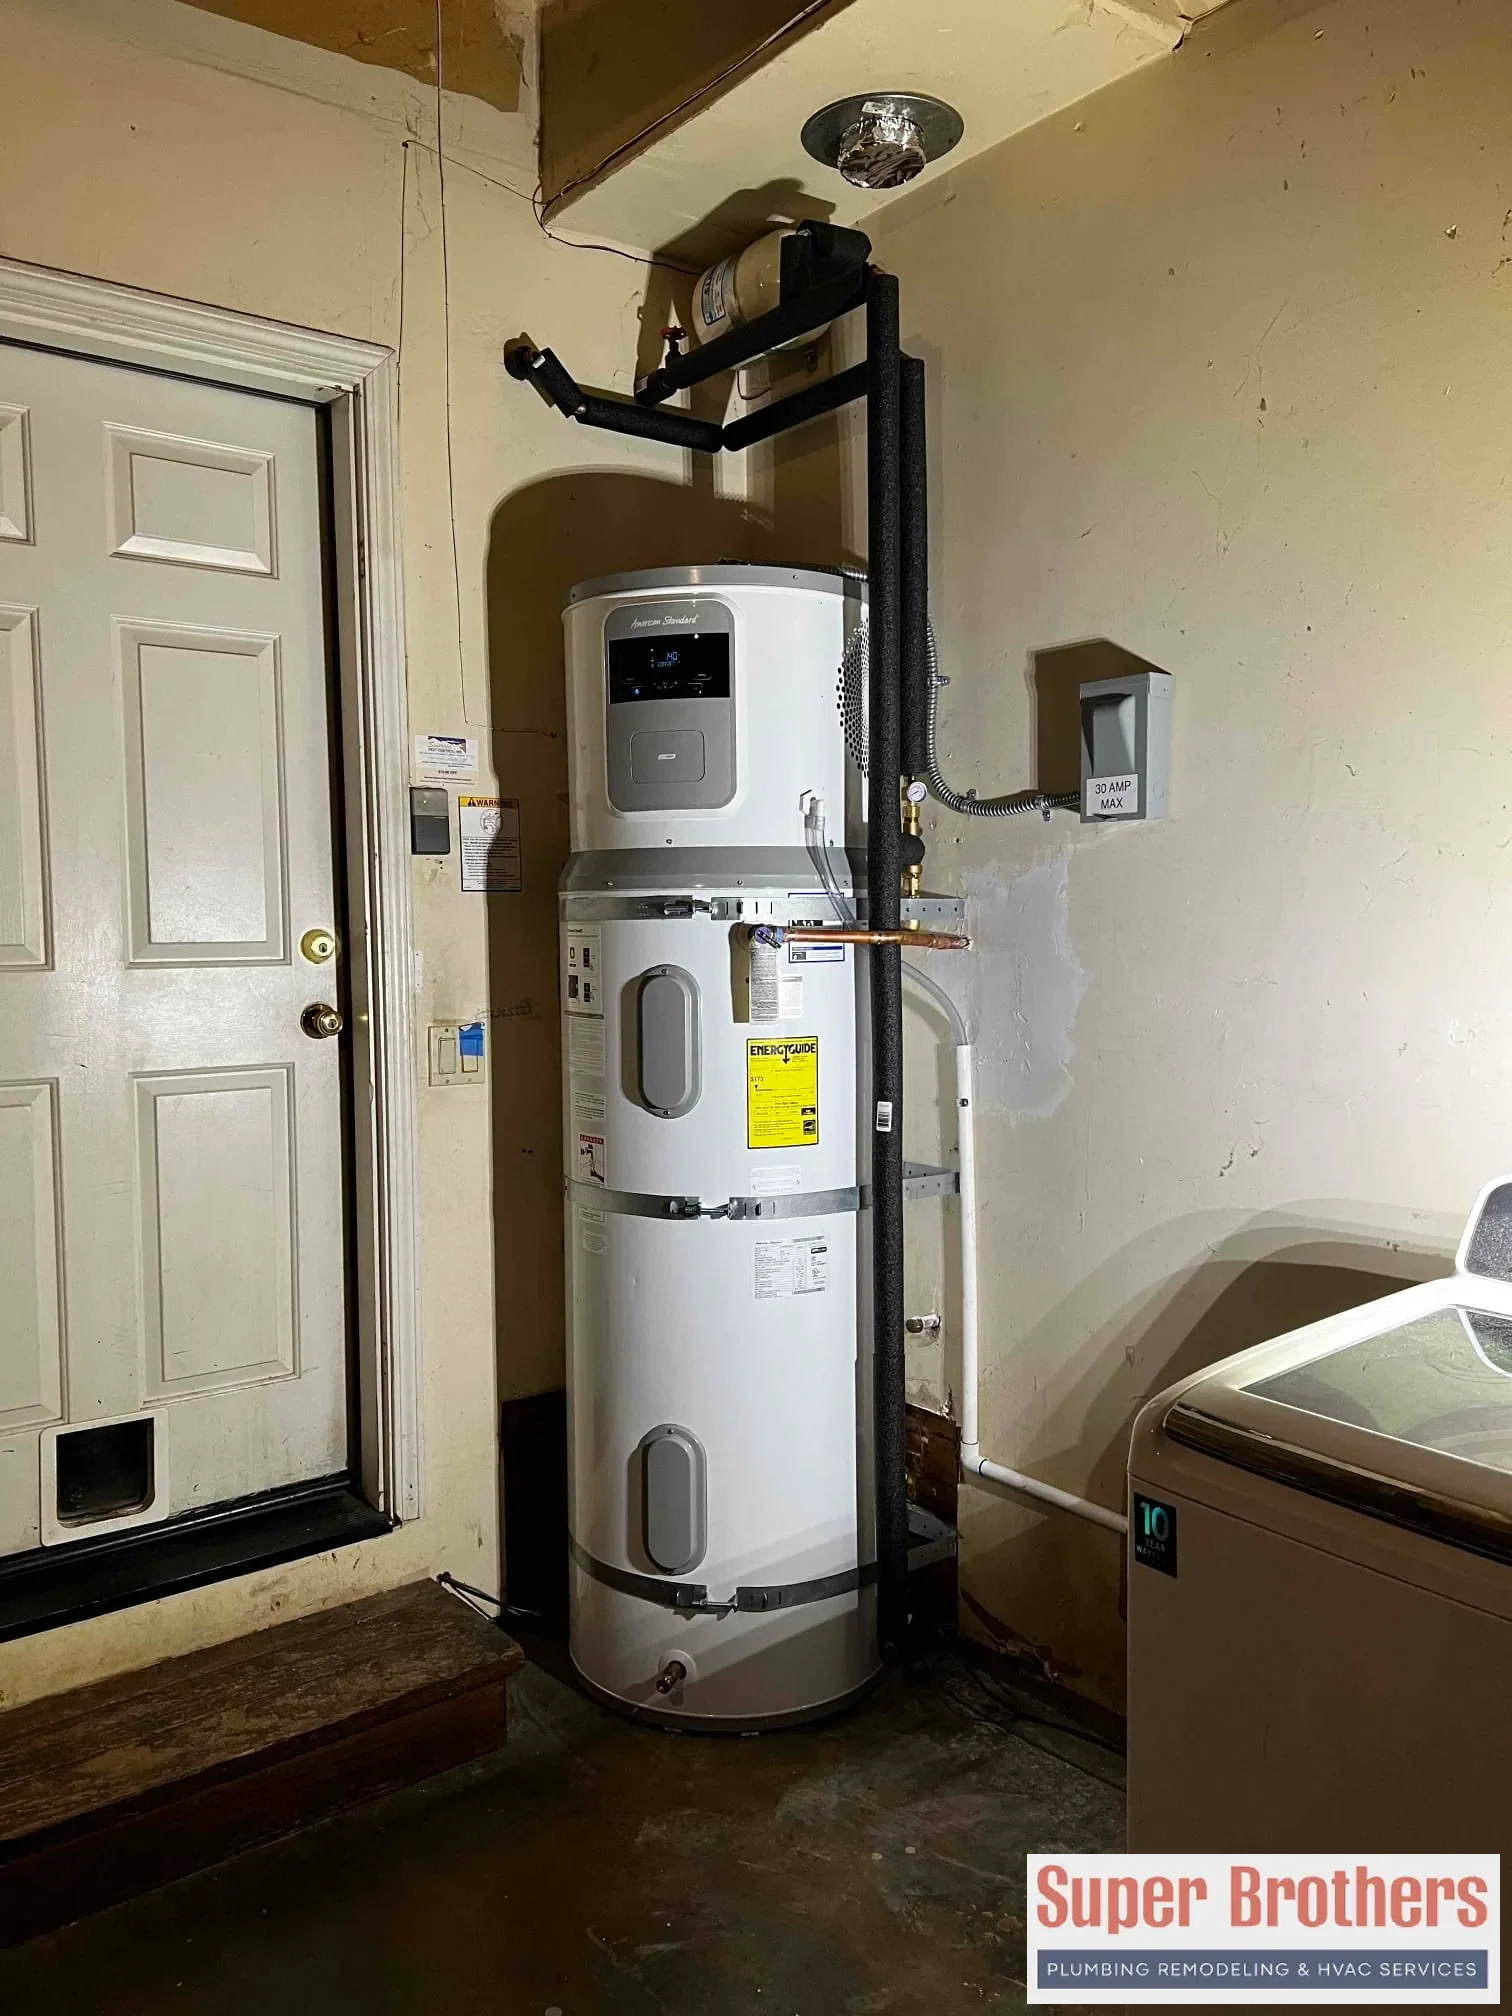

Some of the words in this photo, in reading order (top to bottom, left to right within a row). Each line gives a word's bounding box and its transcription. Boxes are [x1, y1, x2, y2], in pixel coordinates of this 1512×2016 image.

[630, 617, 661, 629] American
[662, 614, 698, 626] Standard
[666, 651, 678, 661] 140
[1095, 783, 1107, 794] 30
[1108, 780, 1132, 794] AMP
[476, 798, 512, 808] WARNING
[1100, 797, 1123, 809] MAX
[1140, 1502, 1169, 1541] 10
